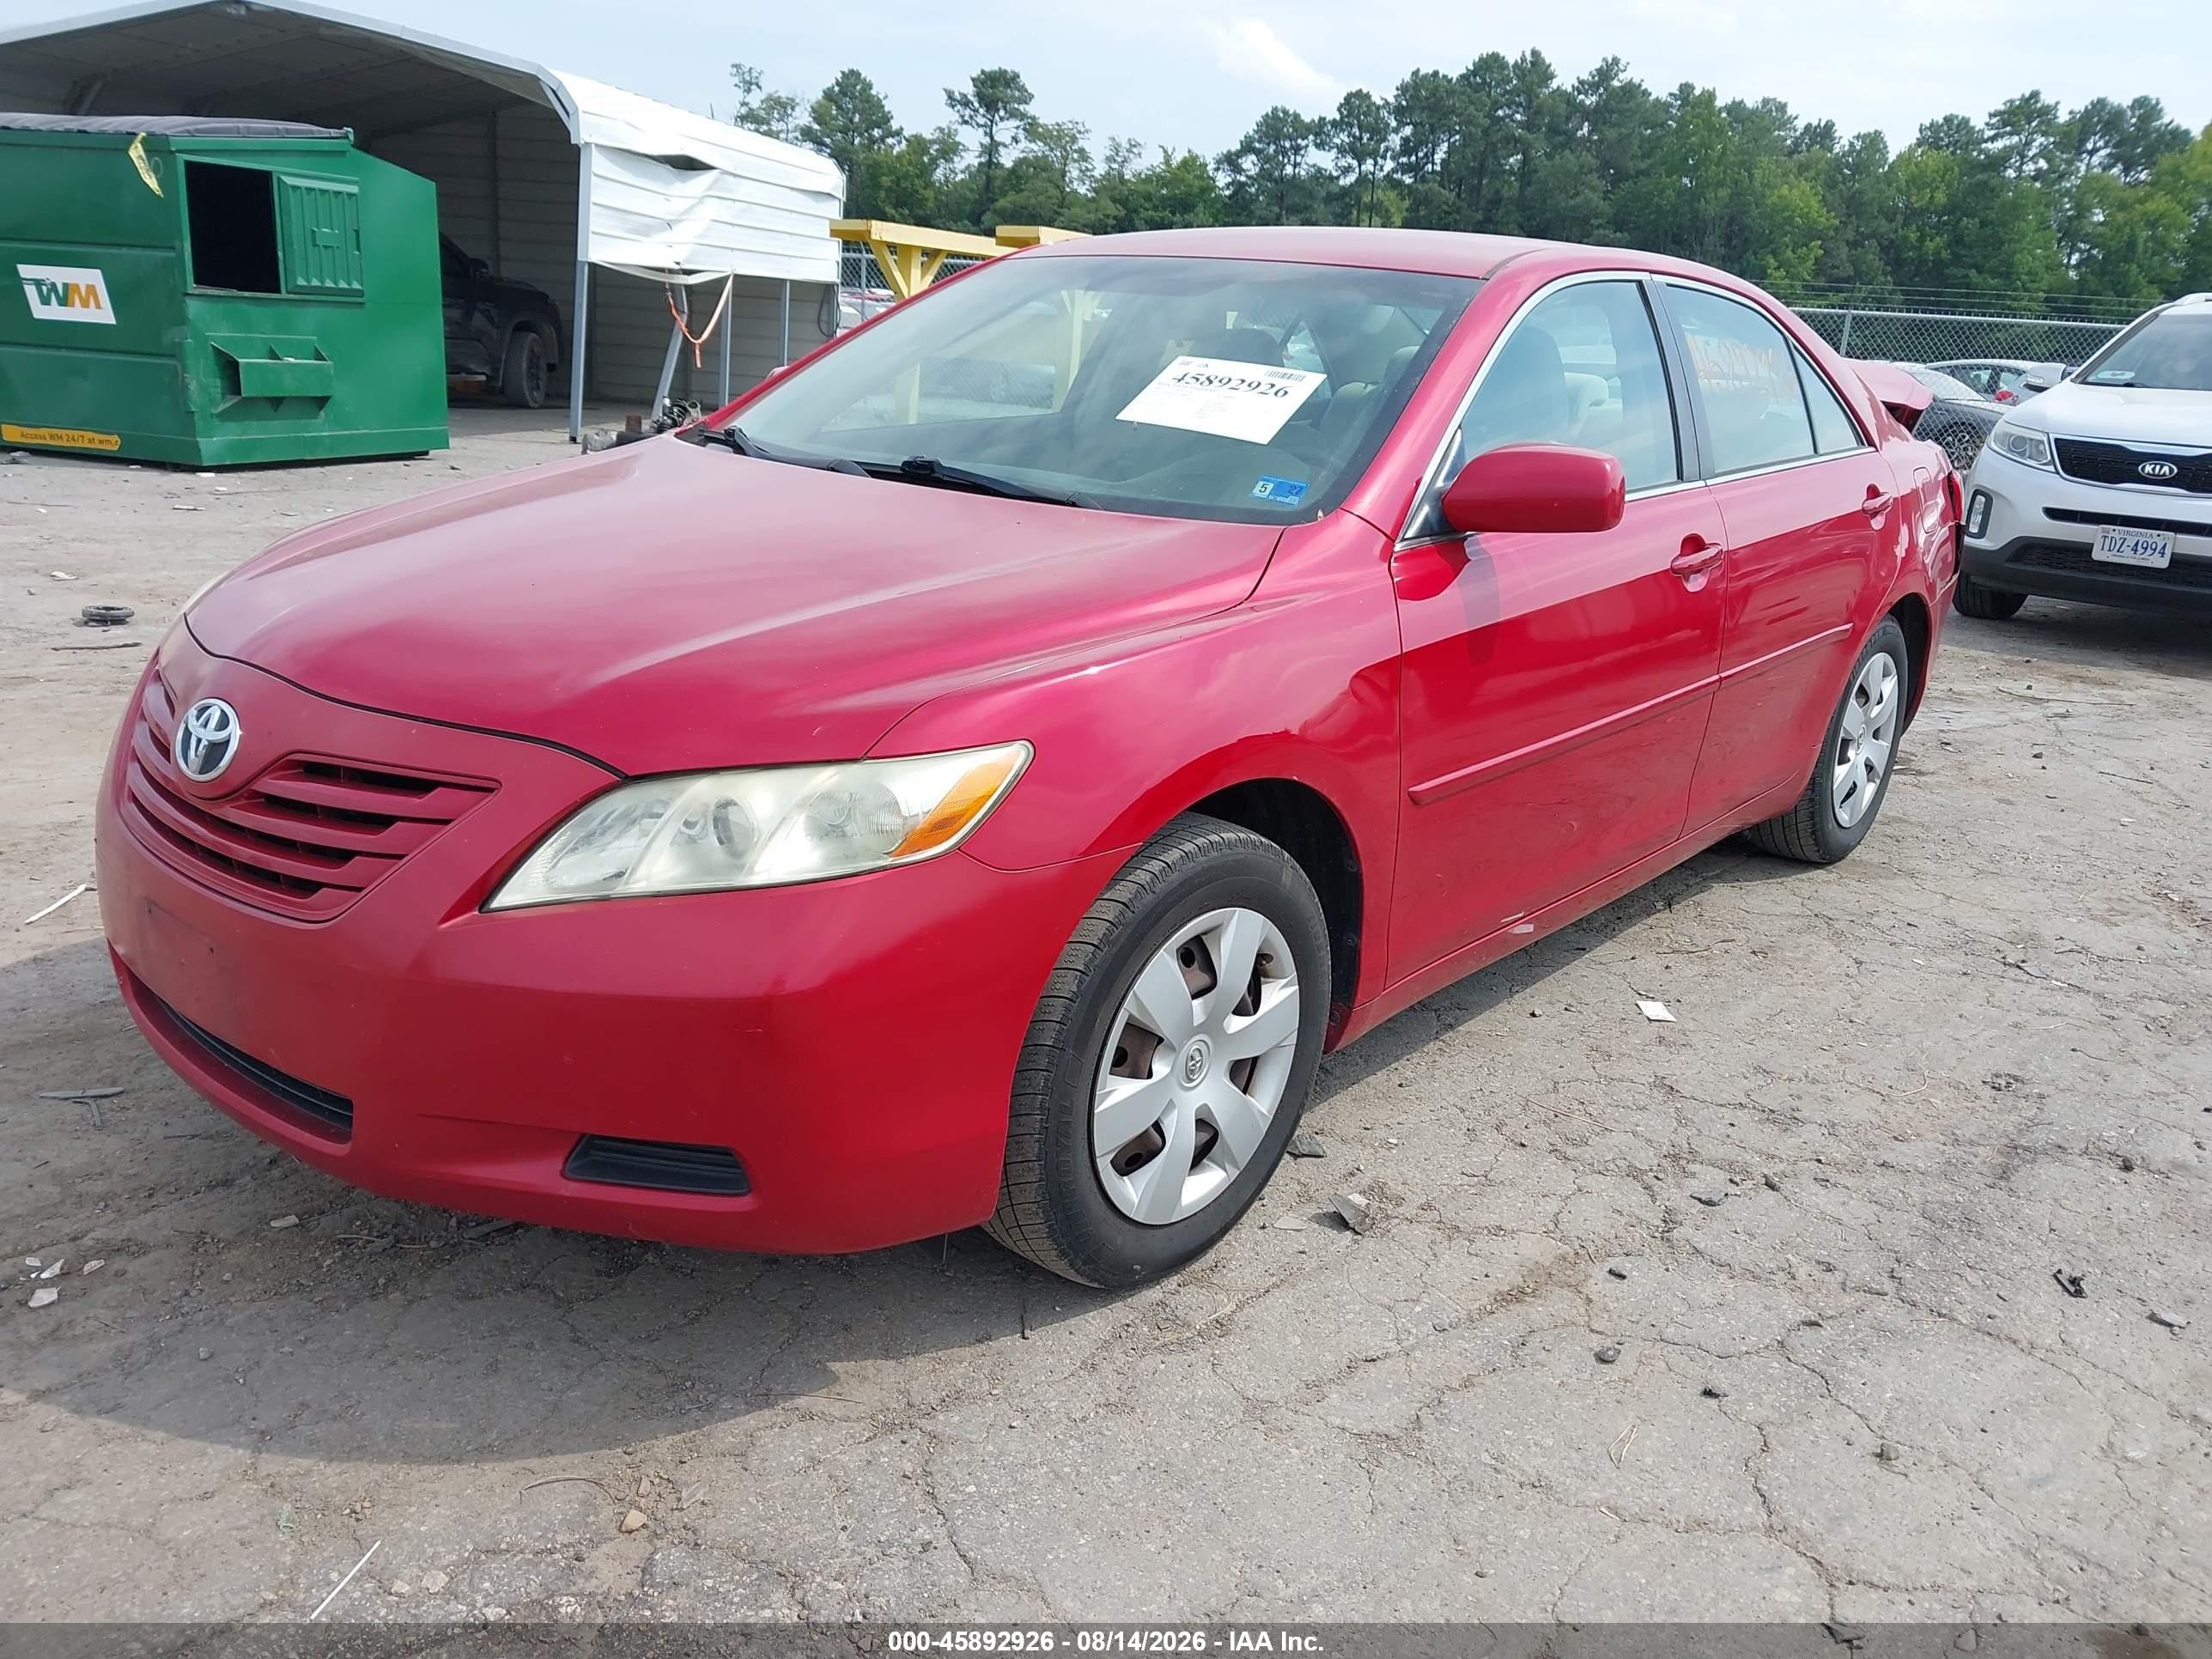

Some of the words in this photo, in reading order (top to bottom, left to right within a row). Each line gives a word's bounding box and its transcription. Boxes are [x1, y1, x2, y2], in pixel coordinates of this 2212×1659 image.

[34, 279, 102, 310] WM
[1172, 371, 1292, 399] 45892926
[21, 431, 46, 441] Access
[48, 433, 64, 441] WM
[65, 434, 85, 443] 24/7
[2144, 464, 2171, 476] KIA
[1259, 483, 1270, 494] 5
[2118, 529, 2154, 538] VIRGINIA
[2100, 535, 2167, 558] TDZ-4994
